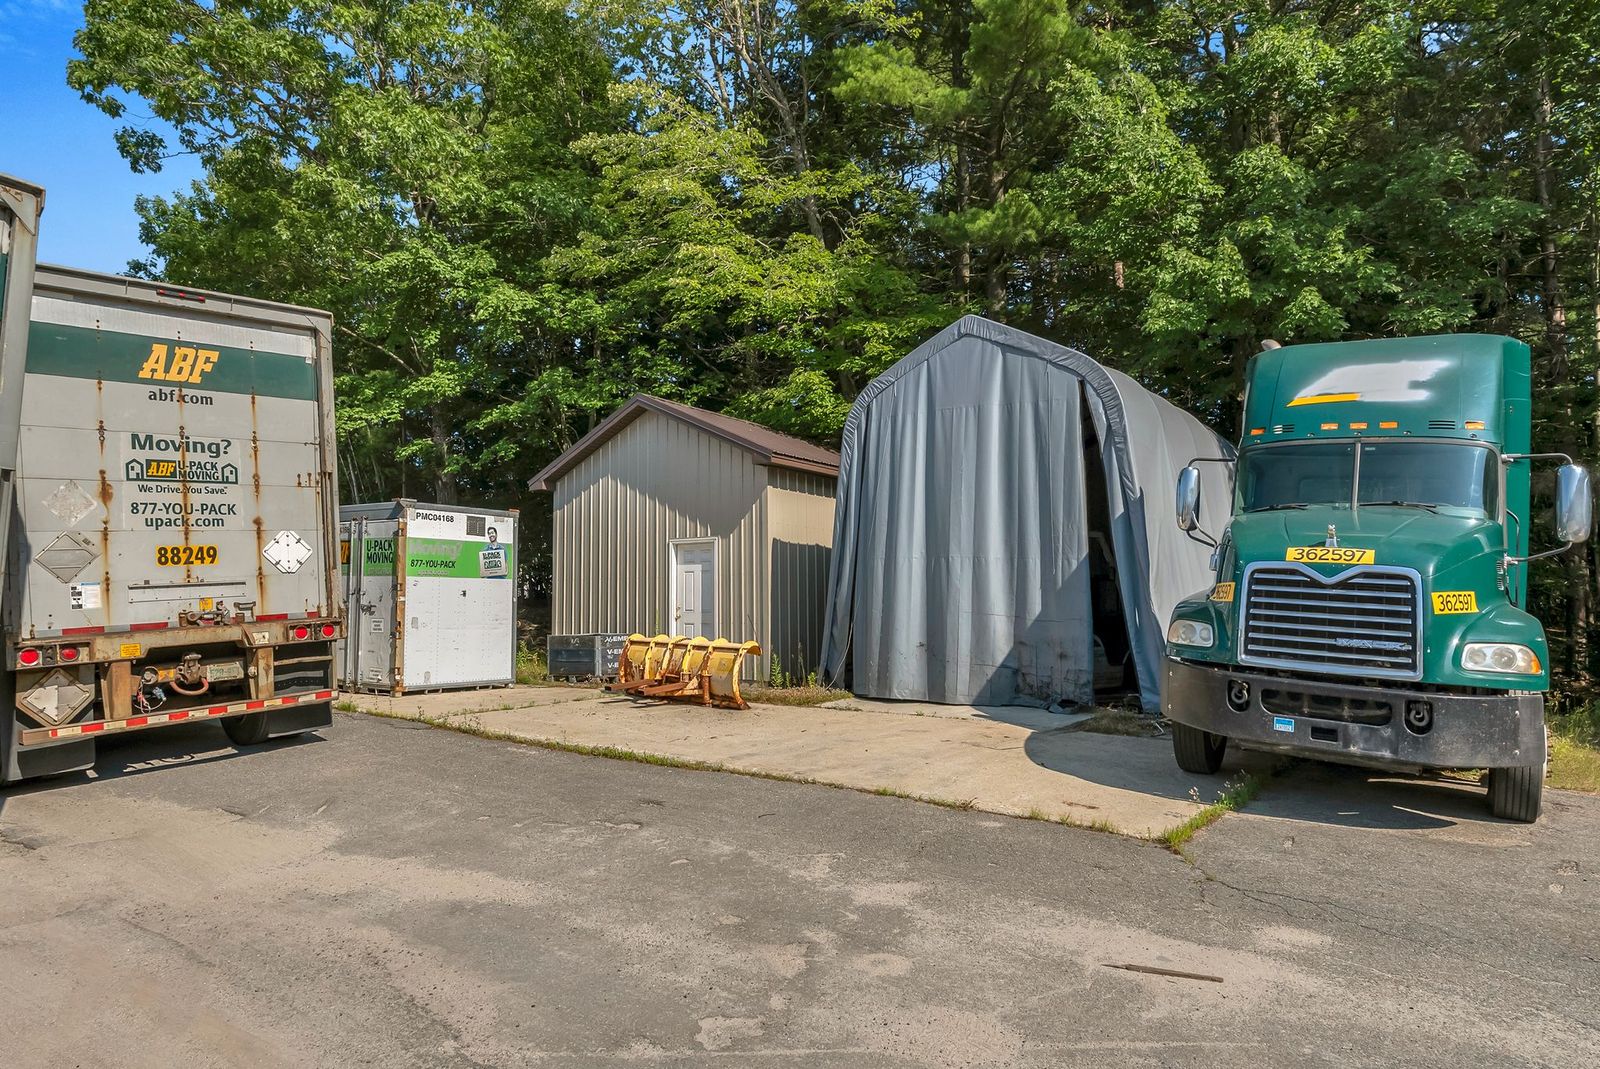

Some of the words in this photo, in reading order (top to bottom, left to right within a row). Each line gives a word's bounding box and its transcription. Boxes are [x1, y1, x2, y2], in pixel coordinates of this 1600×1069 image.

[138, 343, 220, 384] ABF
[148, 388, 213, 406] abf.com
[131, 433, 232, 458] Moving?
[147, 461, 176, 477] ABF
[178, 460, 218, 471] U-PACK
[178, 470, 219, 480] MOVING
[138, 484, 153, 493] We
[155, 484, 183, 494] Drive.
[186, 485, 202, 494] You
[130, 502, 237, 516] 877-YOU-PACK
[145, 515, 224, 531] upack.com
[416, 512, 455, 523] PMC04168
[366, 539, 393, 552] U-PACK
[156, 545, 218, 566] 88249
[366, 551, 393, 564] MOVING
[1292, 547, 1366, 564] 362597
[410, 559, 456, 569] 877-YOU-PACK
[1213, 583, 1232, 600] 62597
[1436, 593, 1474, 613] 362597
